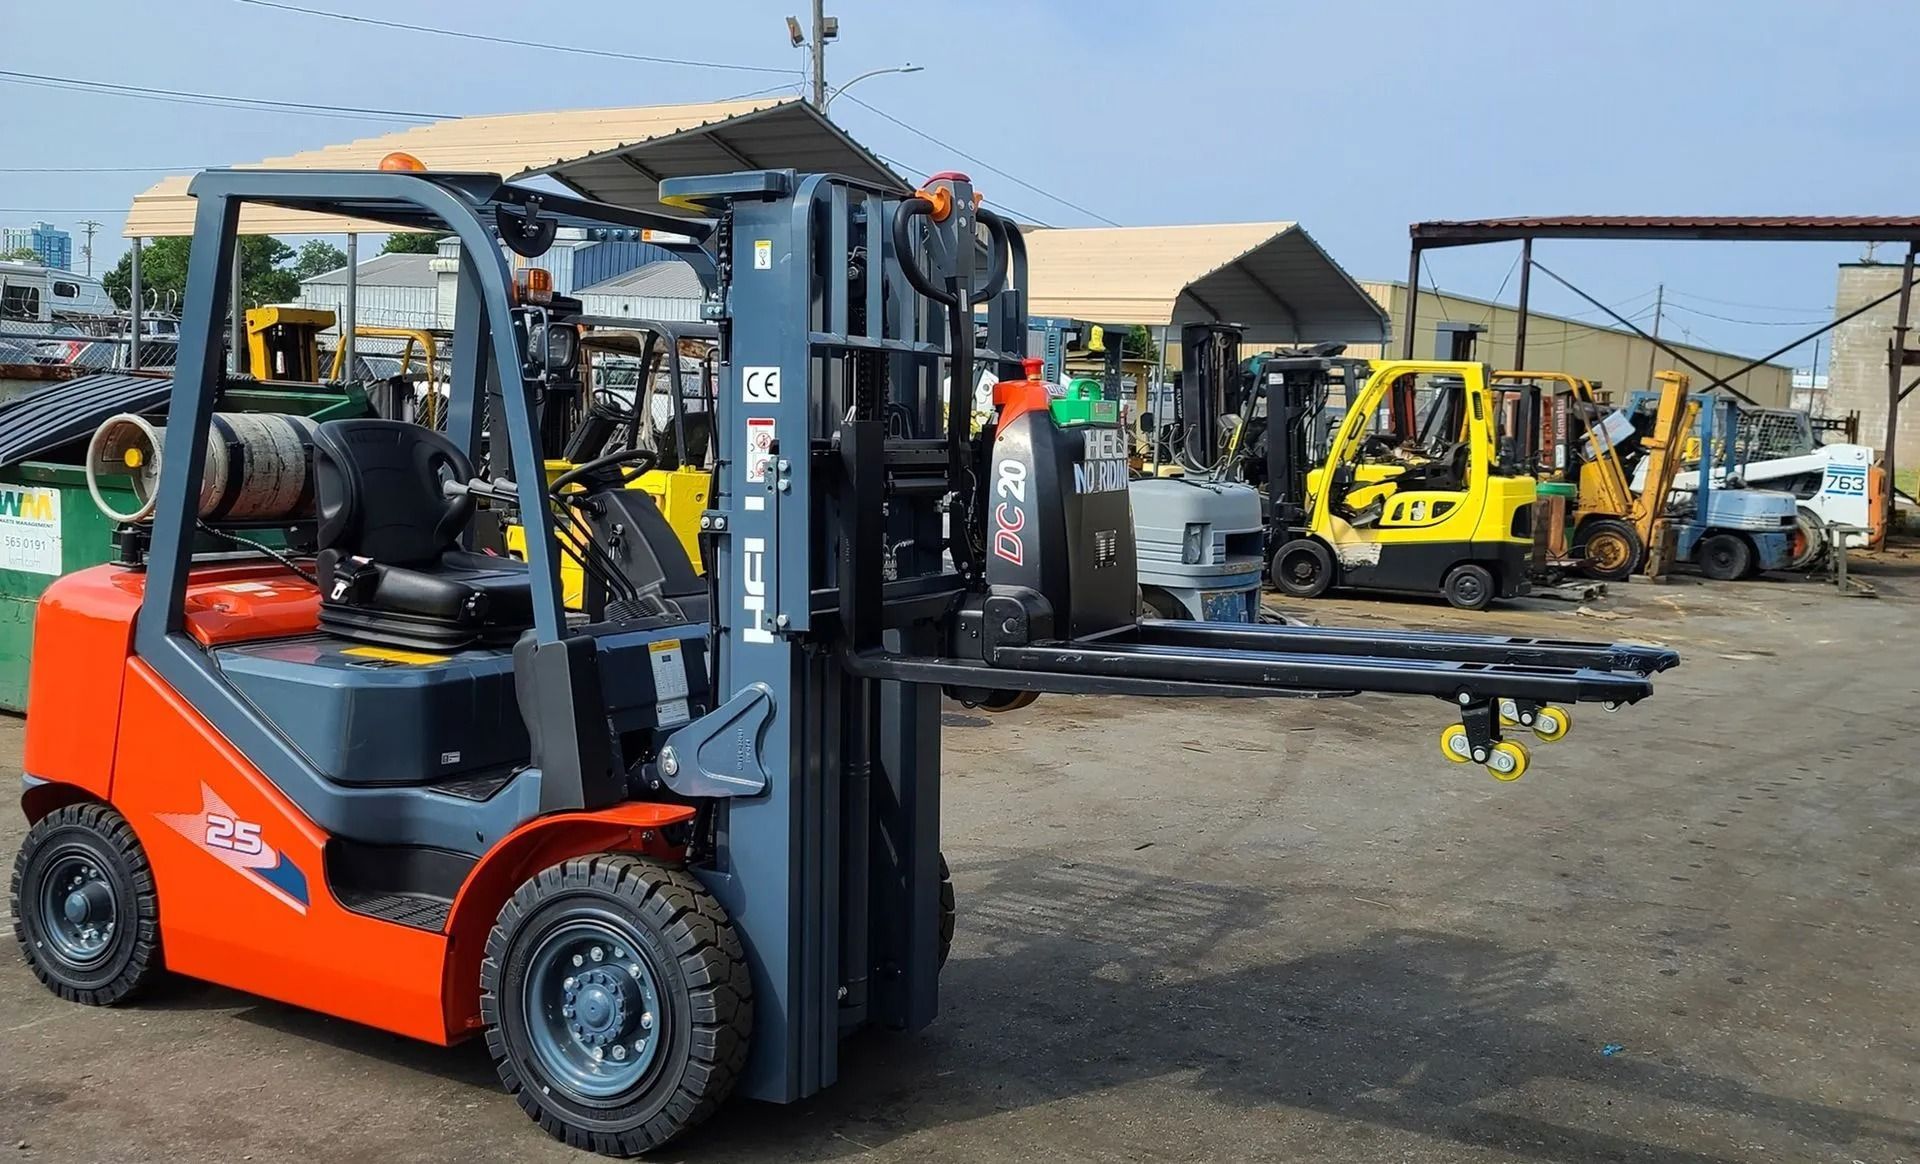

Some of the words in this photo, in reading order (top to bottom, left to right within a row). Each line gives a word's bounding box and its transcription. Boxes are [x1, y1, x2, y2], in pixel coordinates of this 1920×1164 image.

[1556, 399, 1565, 440] Komatsu
[1074, 462, 1096, 494] NO
[1100, 460, 1129, 491] RIDIN
[1826, 474, 1865, 491] 763
[15, 520, 54, 529] MANAGEMENT
[5, 535, 21, 548] 565
[23, 538, 46, 551] 0191
[206, 812, 263, 856] 25
